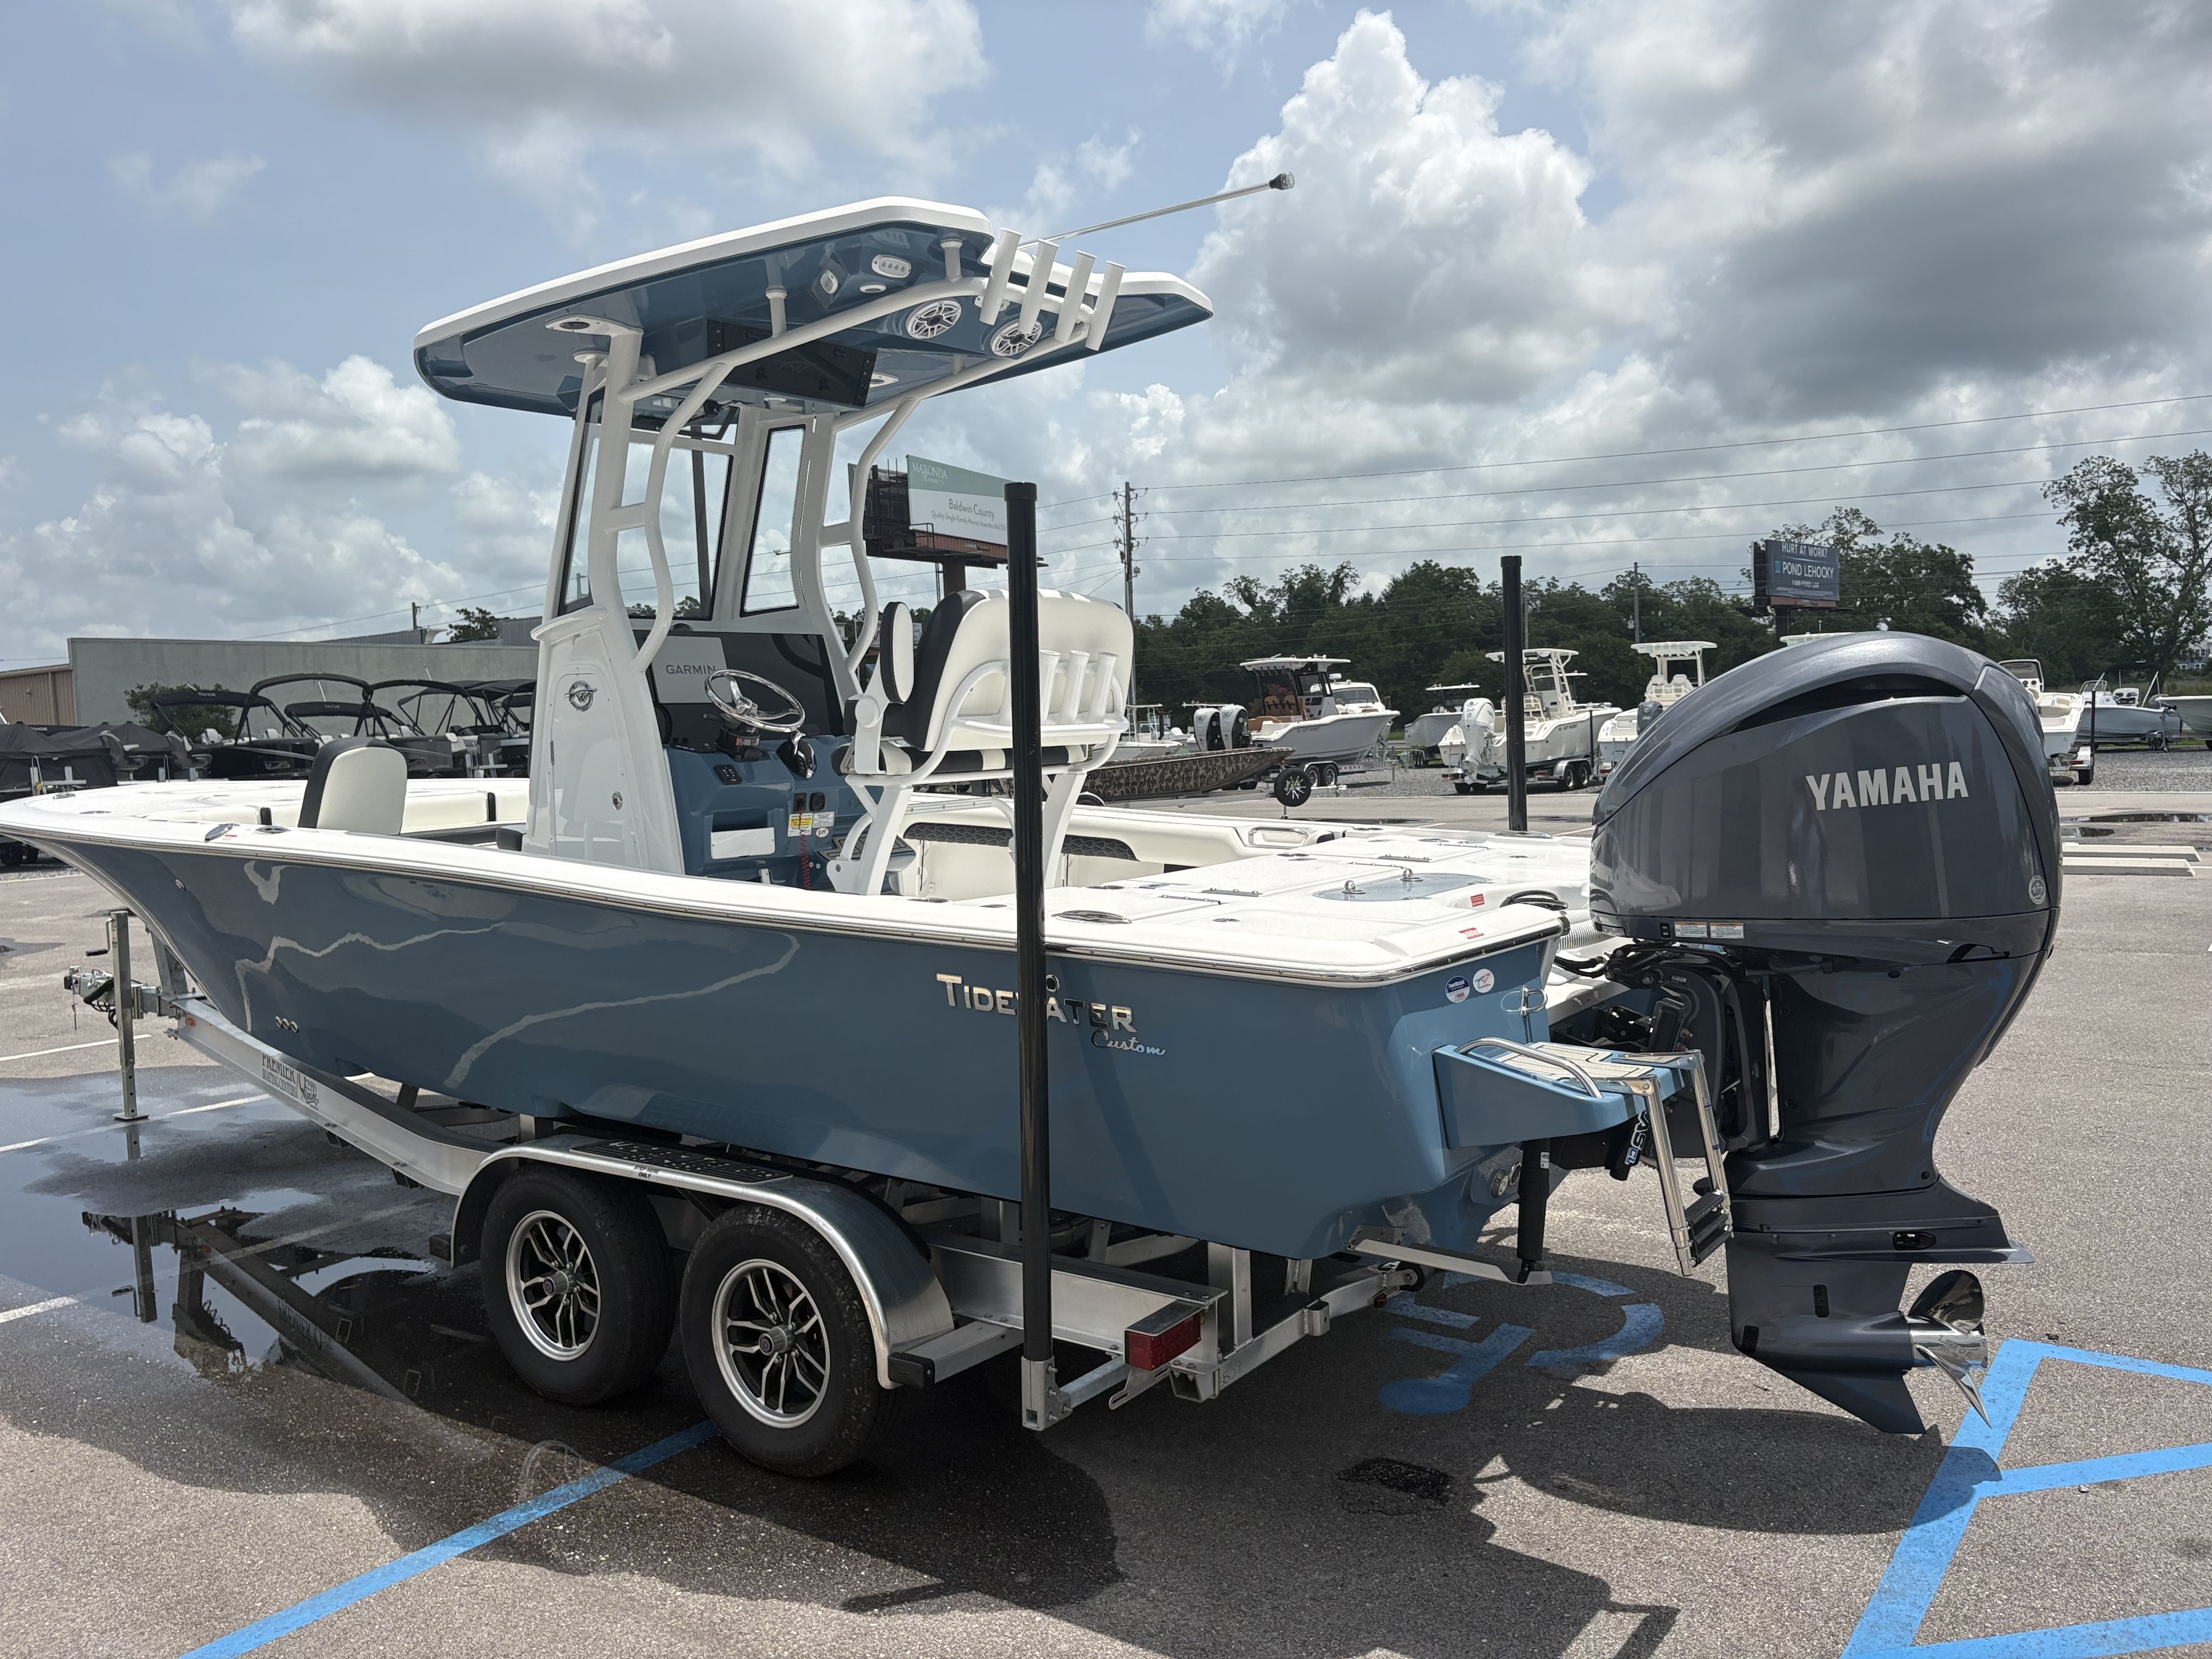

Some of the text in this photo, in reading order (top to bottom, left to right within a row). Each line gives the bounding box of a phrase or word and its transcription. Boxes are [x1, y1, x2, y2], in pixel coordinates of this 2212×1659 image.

[912, 462, 947, 479] MARONDA
[932, 510, 945, 521] Quality
[945, 513, 968, 526] Single-Family
[949, 498, 995, 522] Baldwin County
[1781, 542, 1828, 558] HURT AT WORK?
[1782, 561, 1835, 579] POND LEHOCKY
[665, 664, 716, 674] GARMIN
[1805, 761, 1969, 810] YAMAHA
[936, 972, 1138, 1034] TIDEATER
[1091, 1029, 1166, 1056] Custom
[262, 1053, 296, 1085] PREMIER
